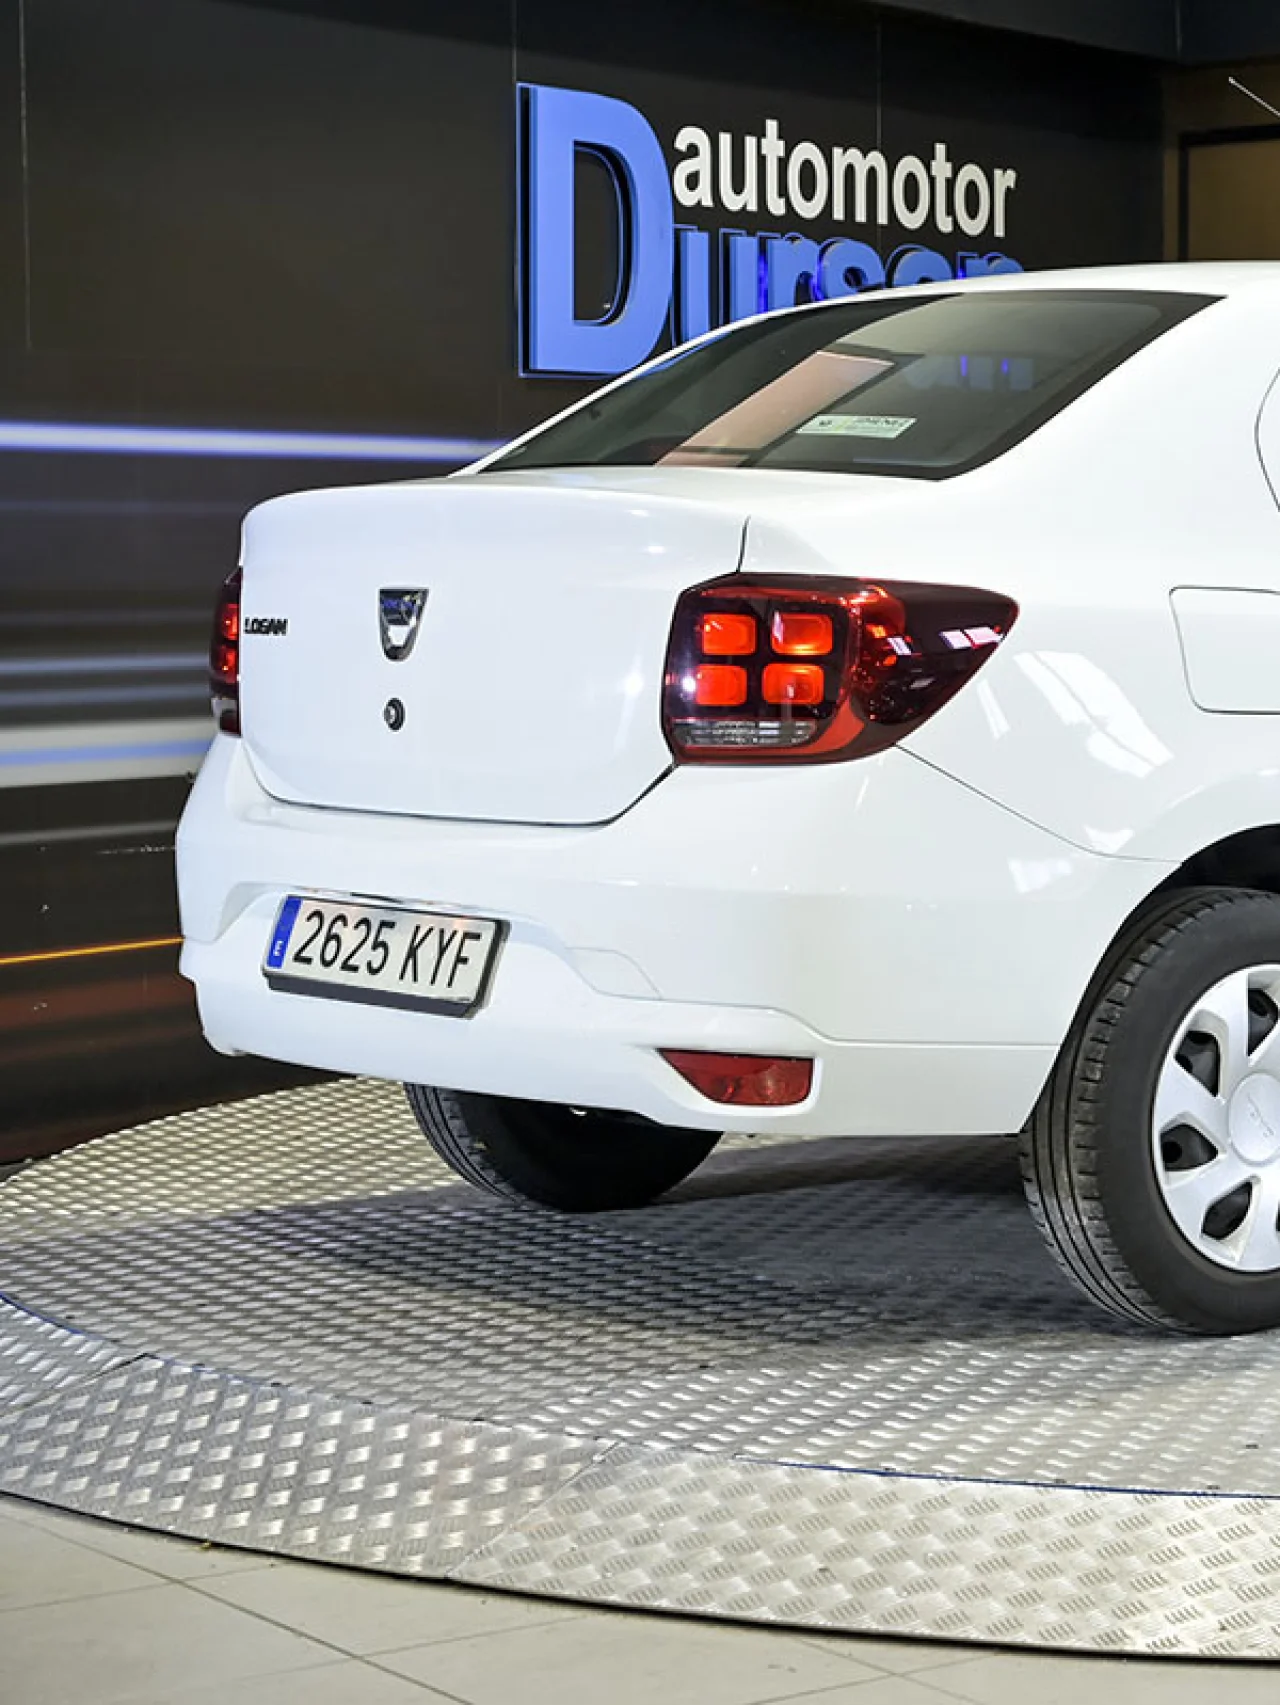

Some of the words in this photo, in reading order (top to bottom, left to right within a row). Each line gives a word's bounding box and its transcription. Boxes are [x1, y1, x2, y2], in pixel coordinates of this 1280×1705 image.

[672, 119, 1017, 237] automotor
[293, 910, 396, 975] 2625
[400, 924, 481, 988] KYF
